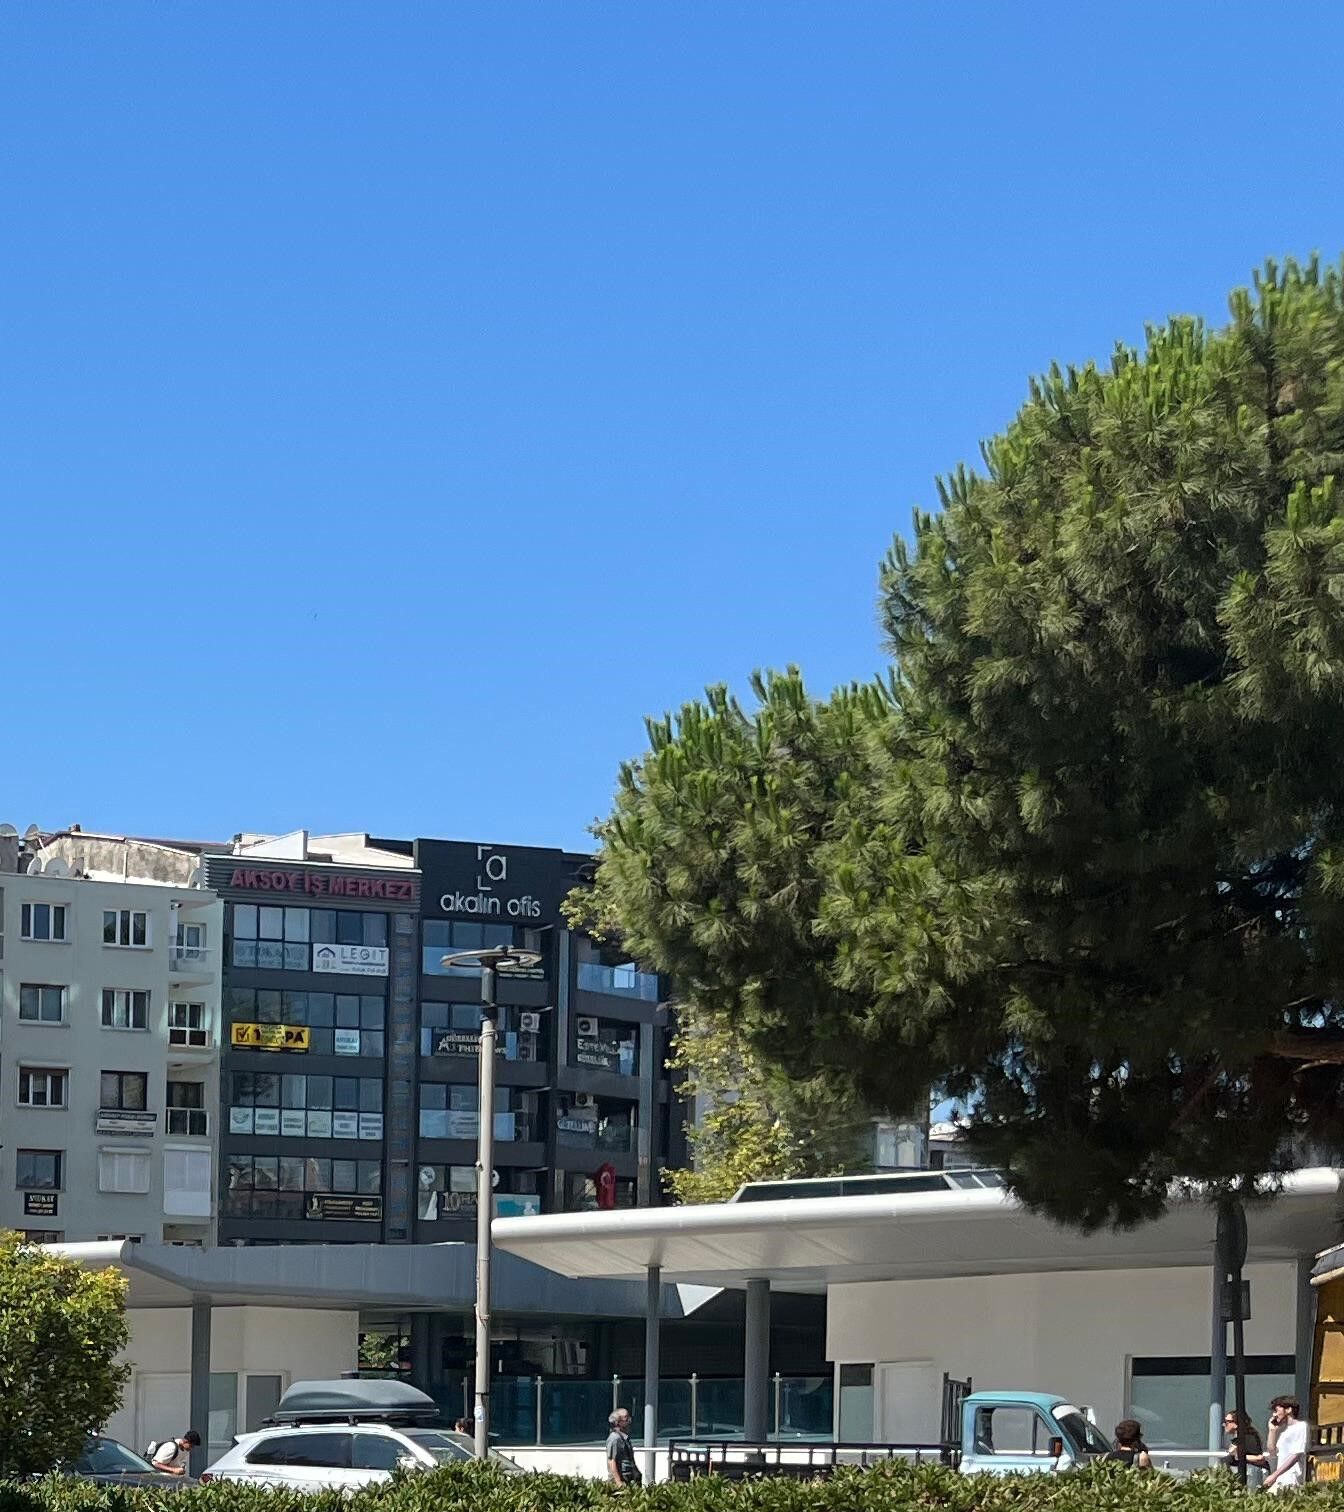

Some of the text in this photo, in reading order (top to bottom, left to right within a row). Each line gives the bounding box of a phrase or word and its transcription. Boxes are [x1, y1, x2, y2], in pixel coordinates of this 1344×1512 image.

[230, 868, 299, 892] AKSOY
[304, 869, 323, 897] İŞ
[507, 895, 541, 917] ofis
